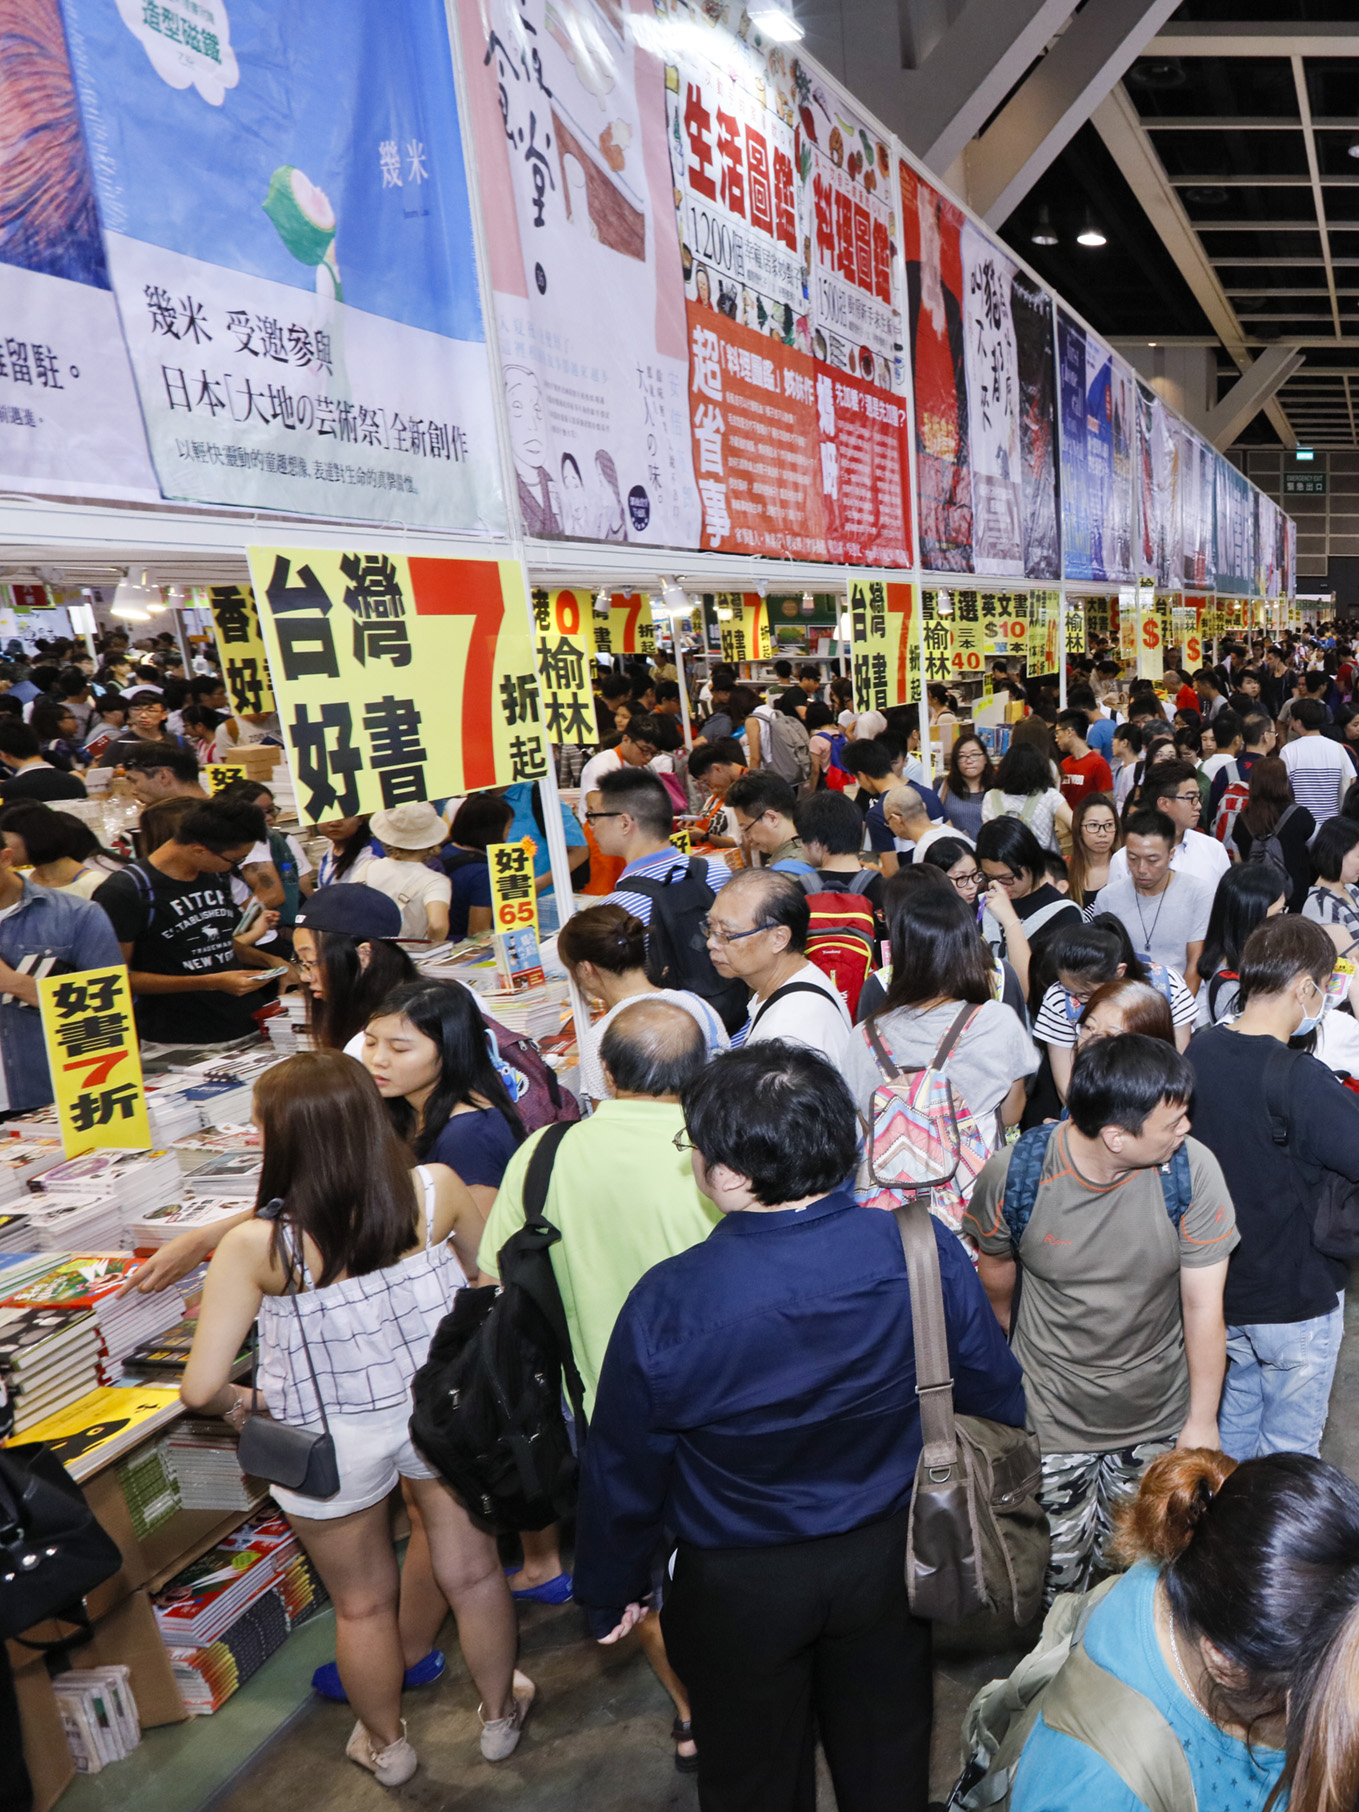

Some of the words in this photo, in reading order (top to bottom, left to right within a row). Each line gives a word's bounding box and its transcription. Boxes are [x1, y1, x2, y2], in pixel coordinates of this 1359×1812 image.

[378, 138, 428, 189] 幾米
[684, 81, 797, 254] 生活圖鑑
[144, 284, 213, 345] 幾米
[226, 309, 334, 377] 受邀參與
[691, 324, 732, 548] 超省事
[265, 552, 413, 680] 台灣
[611, 593, 642, 653] 7
[742, 591, 762, 660] 7
[851, 581, 886, 644] 台灣
[981, 593, 1029, 618] 英文書
[983, 621, 1026, 639] $10
[1065, 611, 1084, 653] 榆林
[1142, 617, 1160, 650] $
[407, 556, 505, 791] 7
[886, 582, 912, 705] 7
[923, 621, 952, 680] 榆林
[536, 635, 594, 745] 榆林
[854, 651, 889, 712] 好書
[288, 695, 428, 824] 好書
[499, 672, 549, 782] 折起
[495, 847, 535, 931] 好書65
[182, 956, 213, 971] NEW
